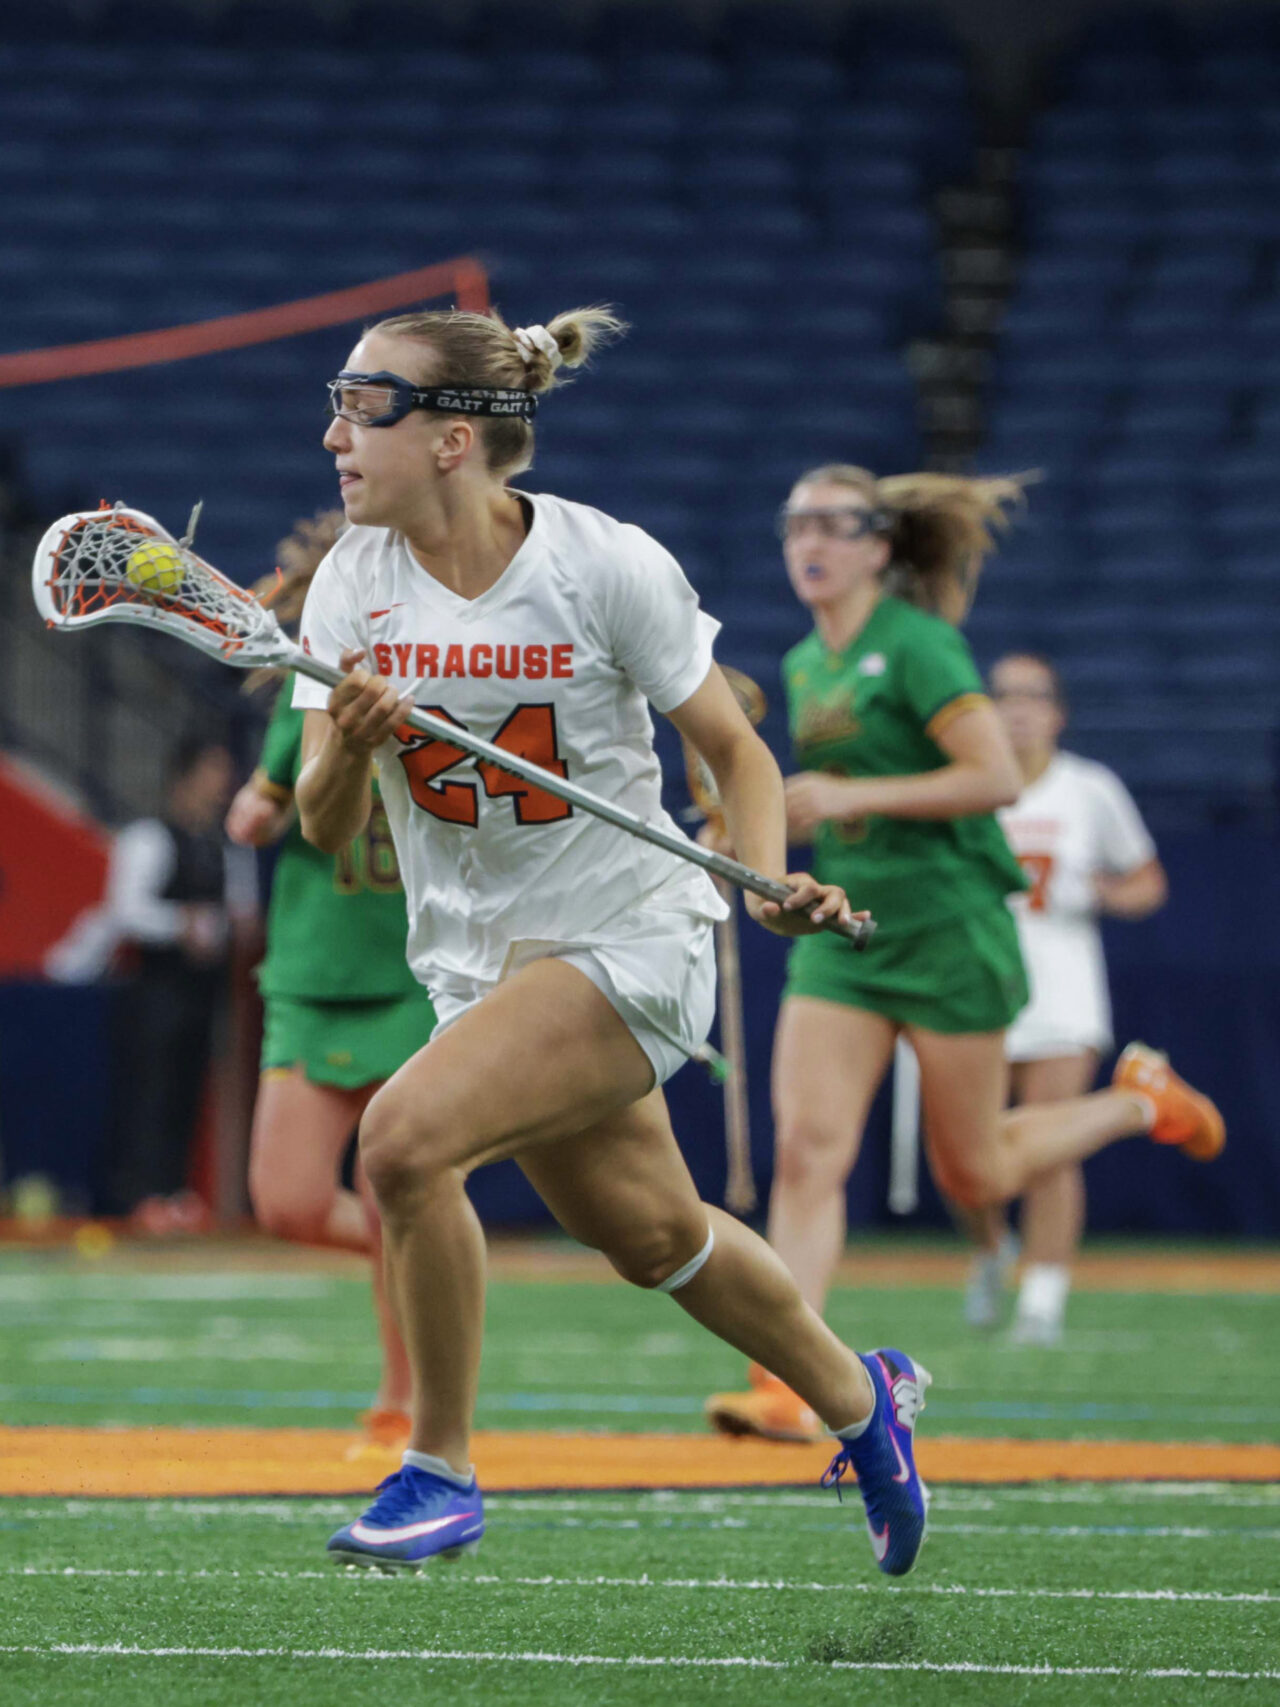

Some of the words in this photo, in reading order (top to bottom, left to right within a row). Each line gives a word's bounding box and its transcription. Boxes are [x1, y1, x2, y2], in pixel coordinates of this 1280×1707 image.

[437, 395, 483, 411] GAIT
[490, 402, 522, 413] GAIT
[373, 643, 574, 679] SYRACUSE
[393, 702, 573, 829] 24
